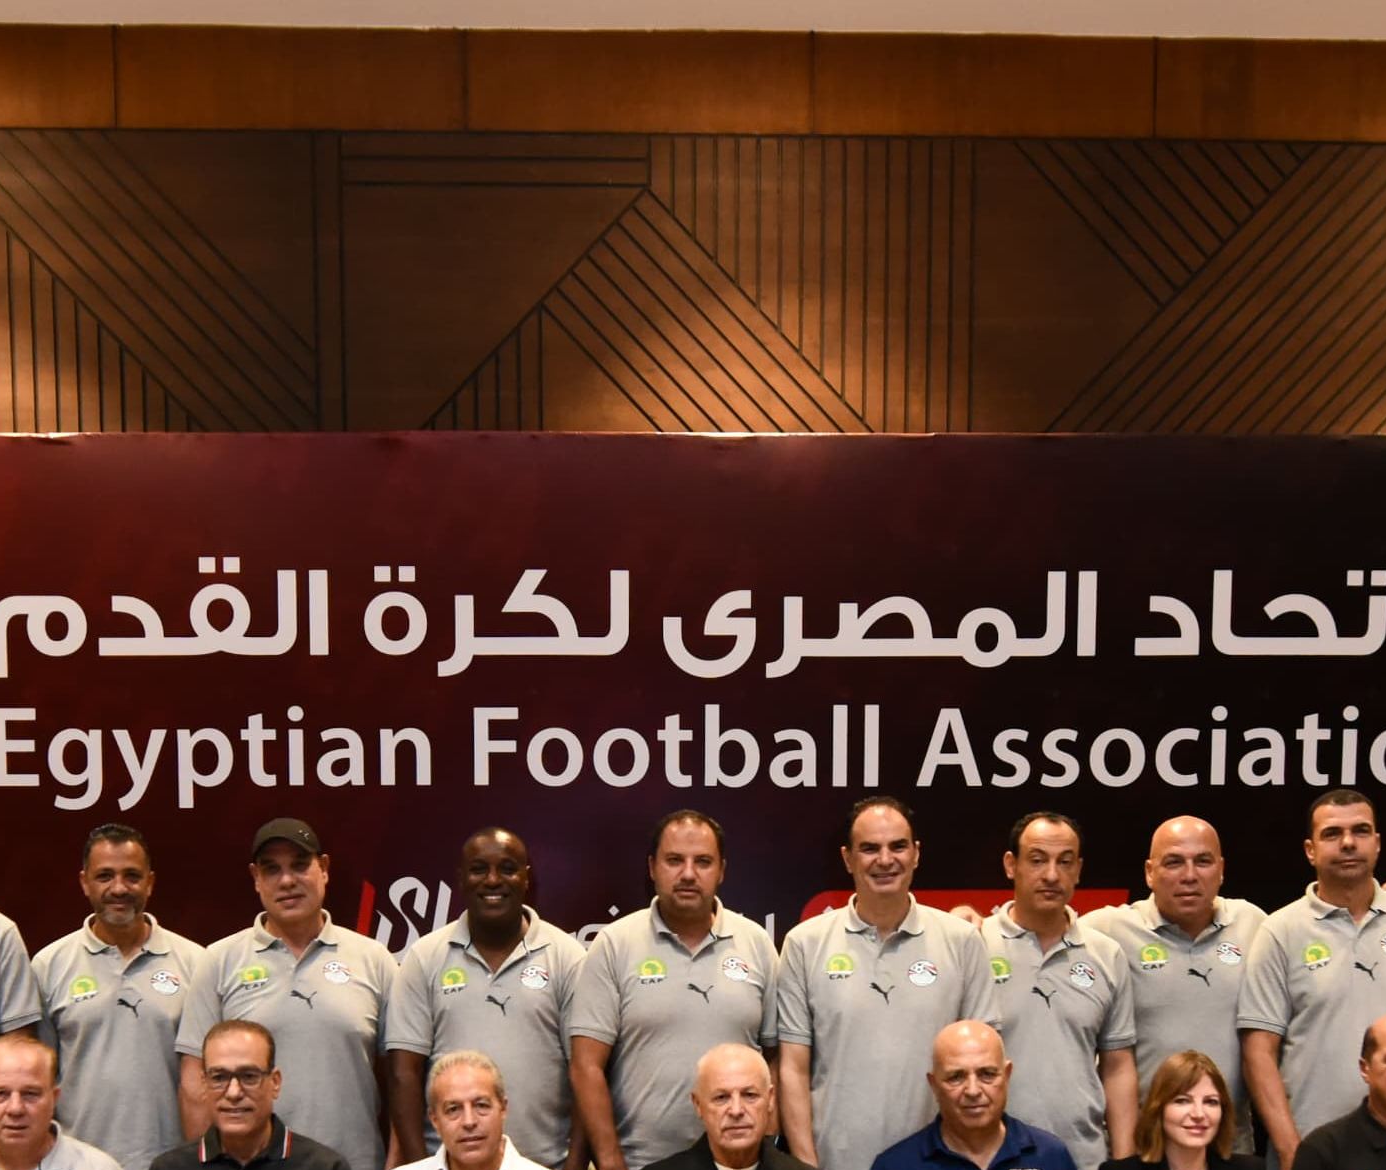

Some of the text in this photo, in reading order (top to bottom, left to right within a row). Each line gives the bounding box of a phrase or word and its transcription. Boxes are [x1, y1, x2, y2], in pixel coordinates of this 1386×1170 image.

[363, 565, 630, 677] لكرة
[663, 570, 1098, 679] المصرى
[473, 704, 881, 788] Football
[443, 986, 466, 995] CAF
[641, 977, 664, 985] CAF
